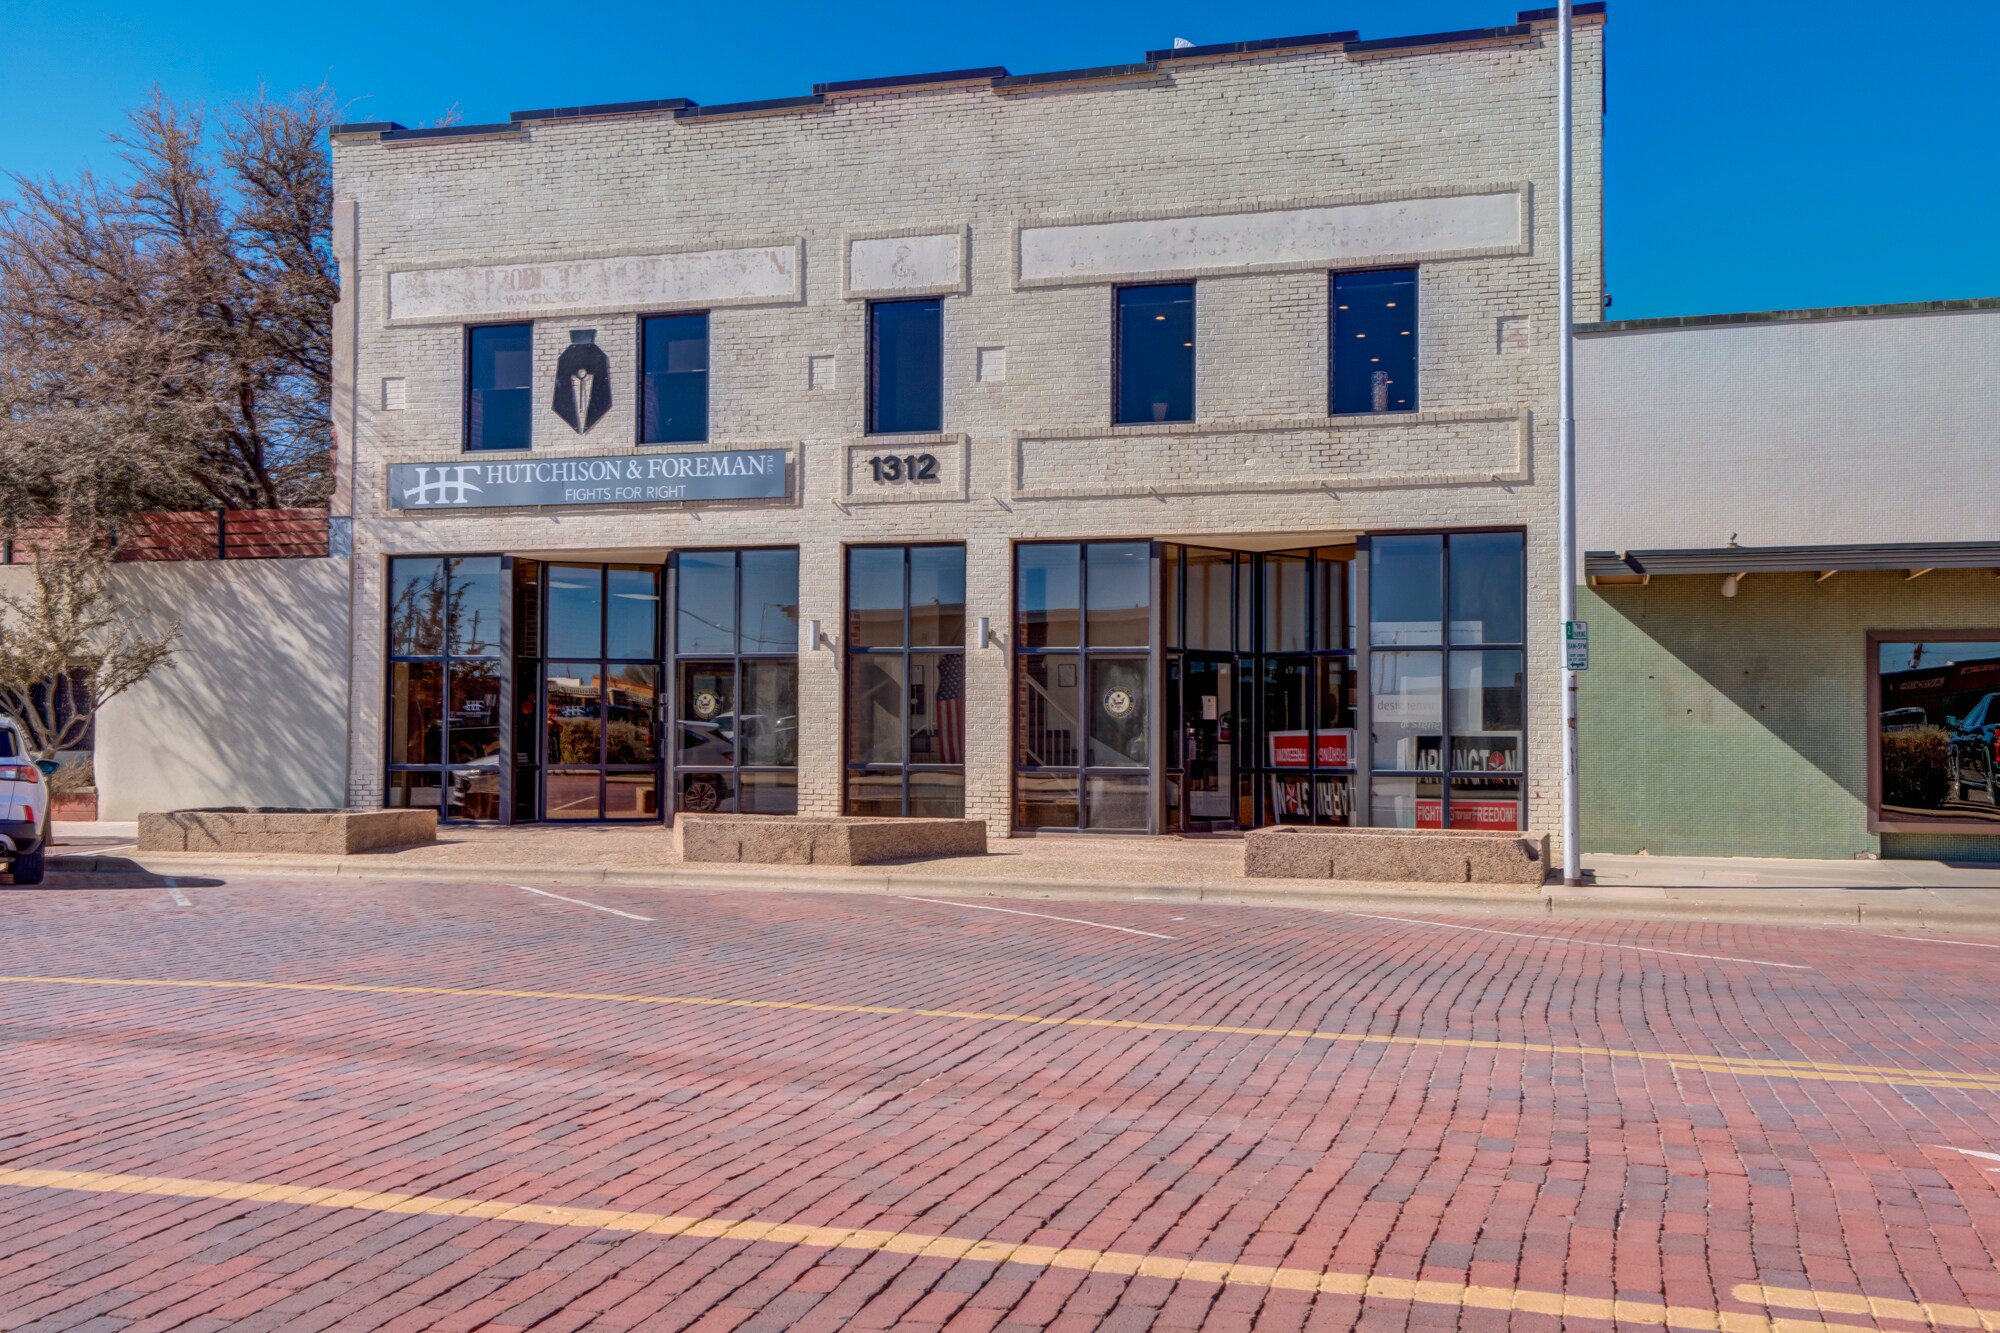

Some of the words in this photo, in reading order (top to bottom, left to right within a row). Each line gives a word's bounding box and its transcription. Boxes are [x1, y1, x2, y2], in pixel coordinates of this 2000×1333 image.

[485, 459, 622, 484] HUTCHISON
[626, 459, 643, 480] &
[647, 455, 766, 479] FOREMAN
[868, 453, 937, 482] 1312
[565, 487, 611, 501] FIGHTS
[615, 486, 642, 500] FOR
[646, 484, 686, 499] RIGHT
